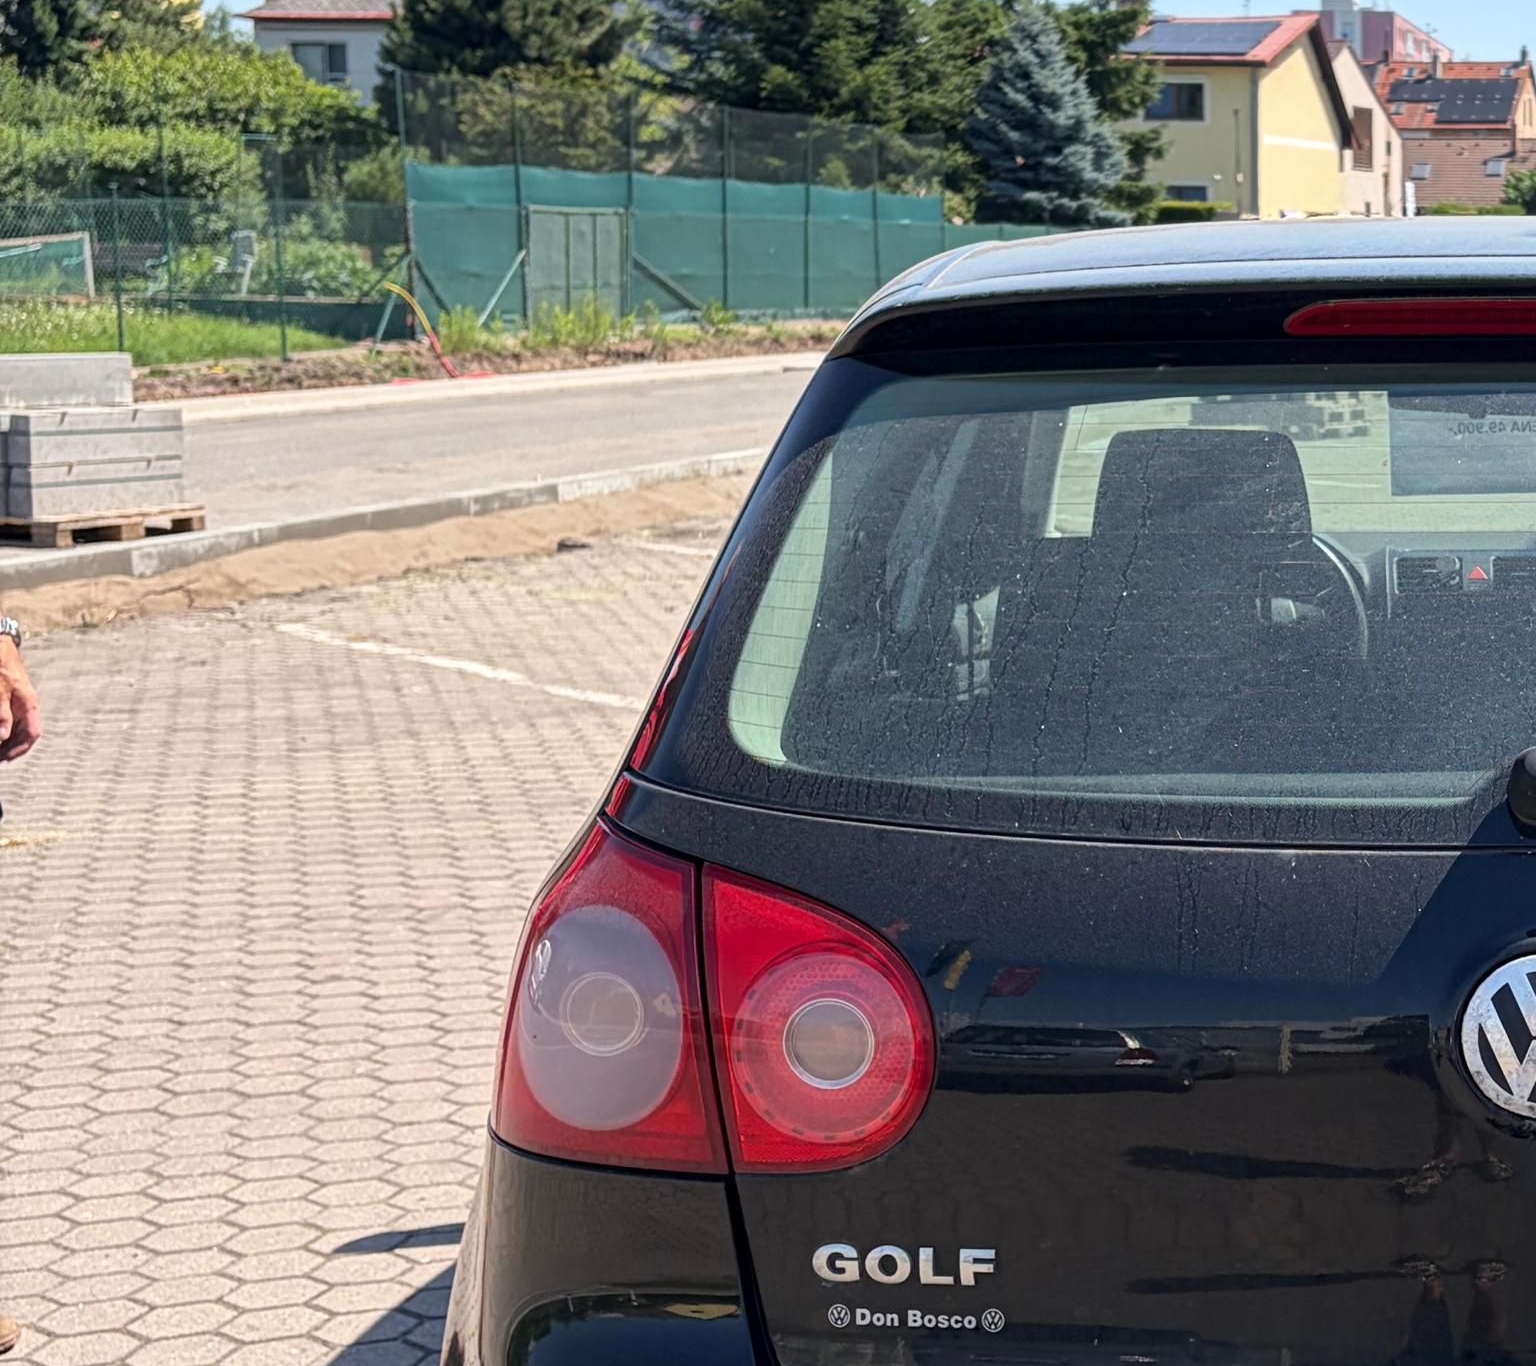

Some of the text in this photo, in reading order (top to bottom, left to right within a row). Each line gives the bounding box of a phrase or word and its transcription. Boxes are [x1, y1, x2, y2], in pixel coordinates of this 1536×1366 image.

[811, 1242, 997, 1287] GOLF
[855, 1307, 900, 1328] Don
[907, 1309, 978, 1330] Bosco
